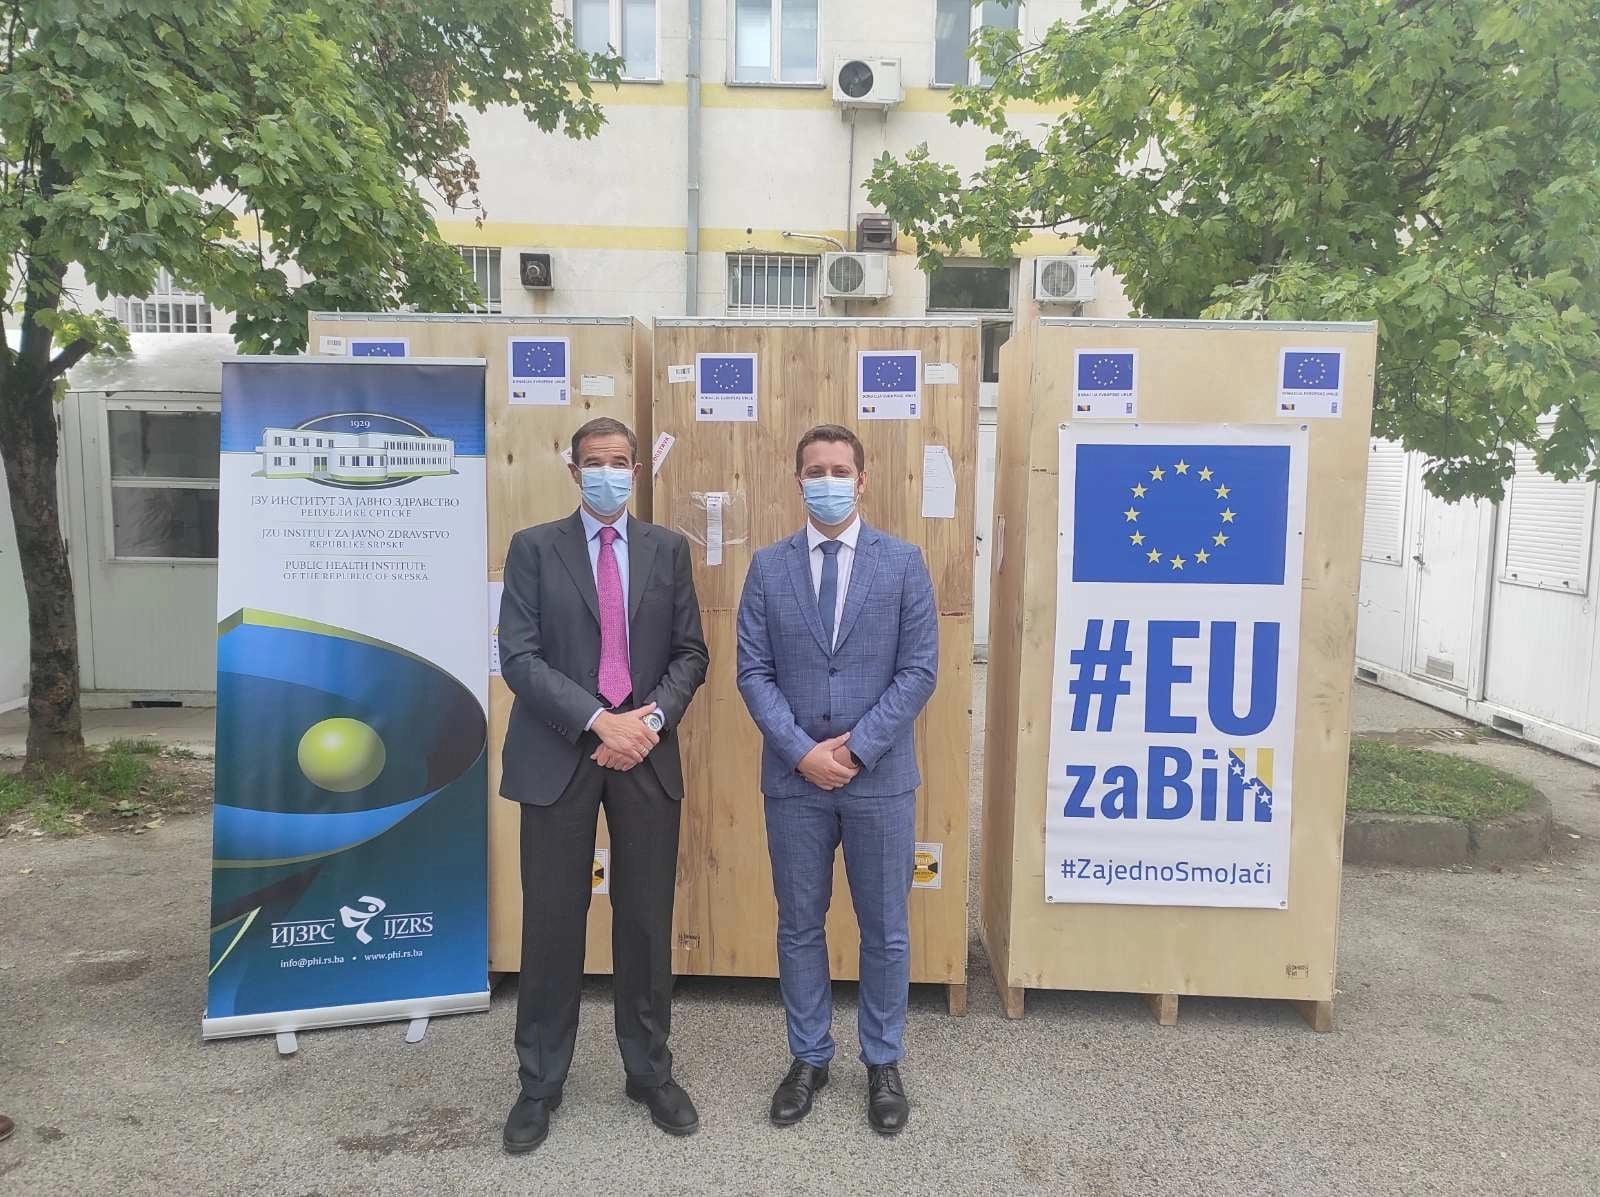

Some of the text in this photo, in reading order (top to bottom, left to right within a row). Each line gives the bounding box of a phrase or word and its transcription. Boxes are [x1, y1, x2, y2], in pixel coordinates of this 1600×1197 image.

[350, 420, 370, 428] 1929
[271, 496, 336, 507] ИНСТИТУТ
[339, 496, 353, 507] ЗА
[355, 496, 392, 507] ЈАВНО
[395, 497, 459, 508] ЗДРАВСТВО
[301, 509, 412, 518] РЕПУБЛИКЕ СРПСКЕ
[261, 528, 450, 540] JZU INSTITUT ZA JAVNO ZDRAVSTVO
[310, 541, 405, 549] REPUBLIKE SRPSKE
[285, 561, 427, 571] PUBLIC HEALTH INSTITUTE
[283, 572, 428, 581] OF THE REPUBLIC OF SRPSKA
[1069, 619, 1281, 736] #EU
[1061, 859, 1271, 885] #ZajednoSmoJači
[384, 916, 433, 938] IJZRS
[280, 950, 423, 968] info@phi.rs.ba www.phi.rs.ba
